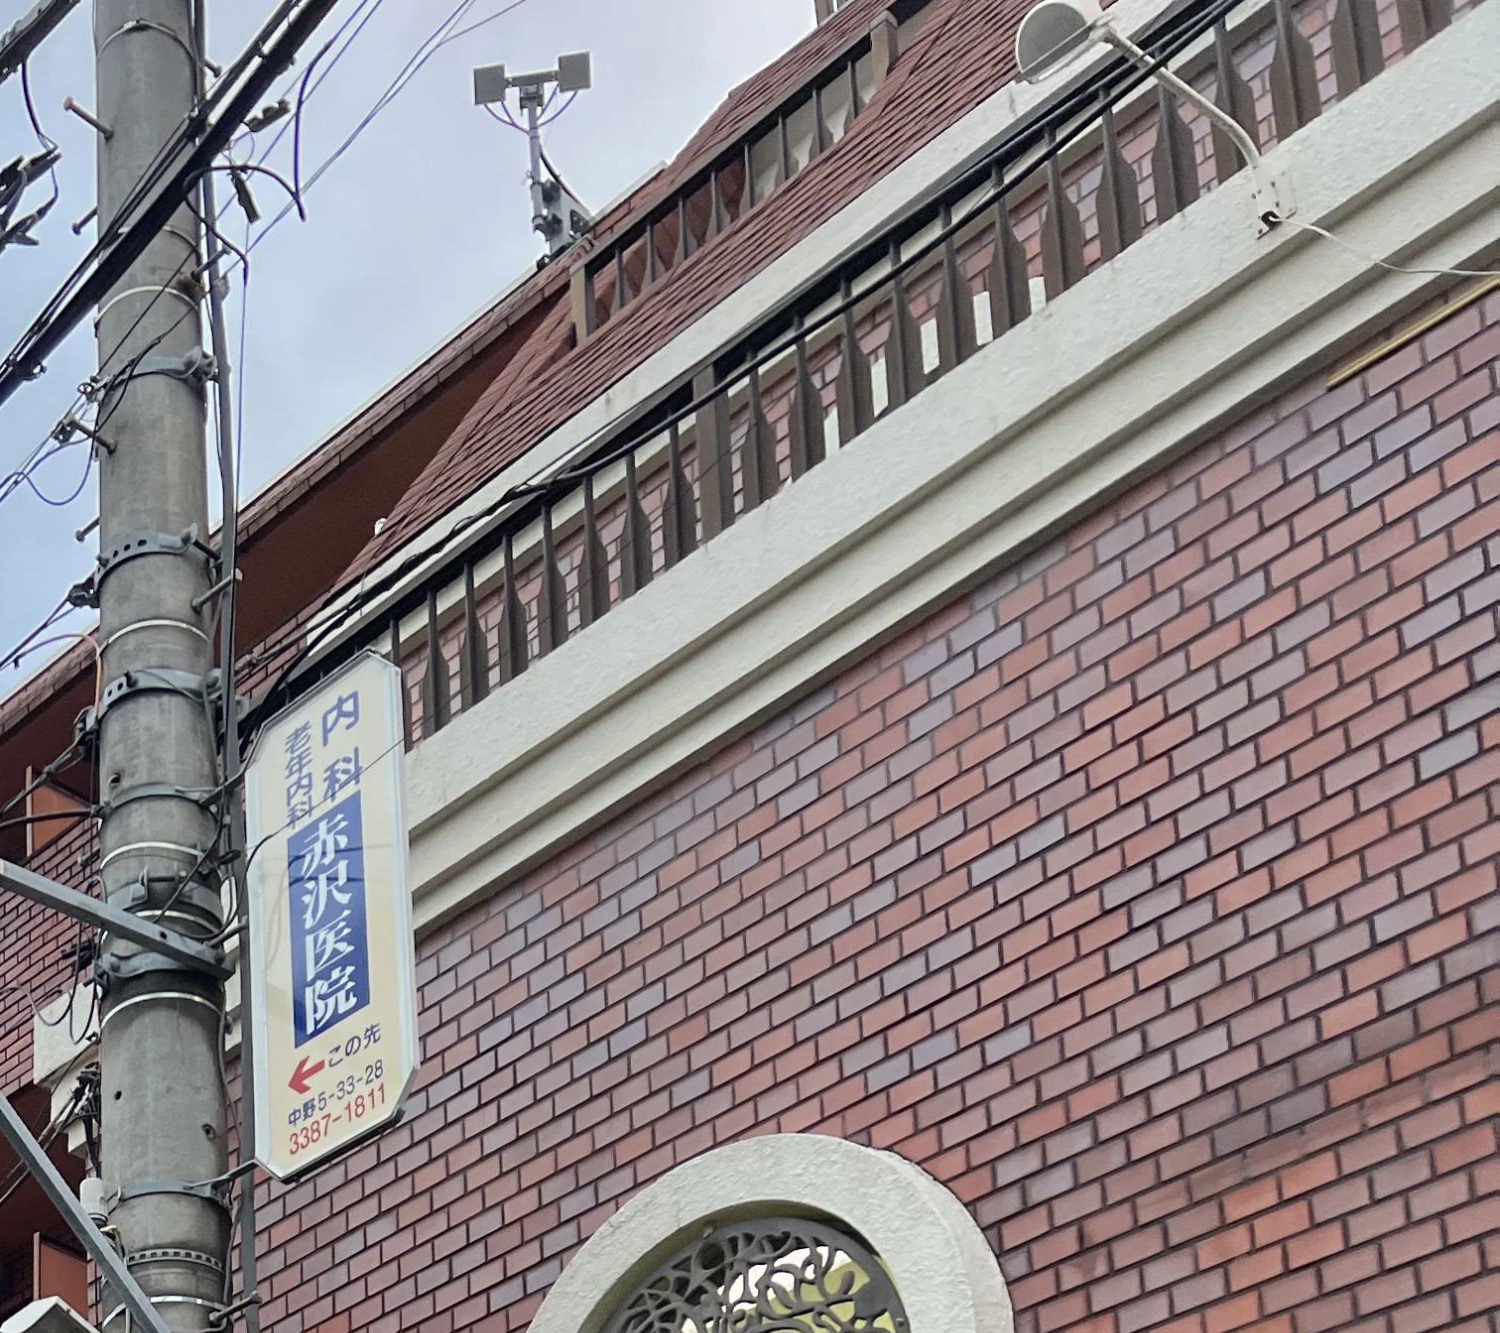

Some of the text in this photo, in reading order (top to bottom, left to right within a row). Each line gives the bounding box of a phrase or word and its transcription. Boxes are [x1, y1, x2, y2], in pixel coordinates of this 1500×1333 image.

[284, 719, 314, 829] 老年内科
[322, 690, 363, 803] 内科
[301, 812, 358, 1036] 赤沢医院
[328, 1023, 381, 1068] この先
[288, 1059, 384, 1127] 中野5-33-28
[289, 1082, 385, 1155] 3387-1811
